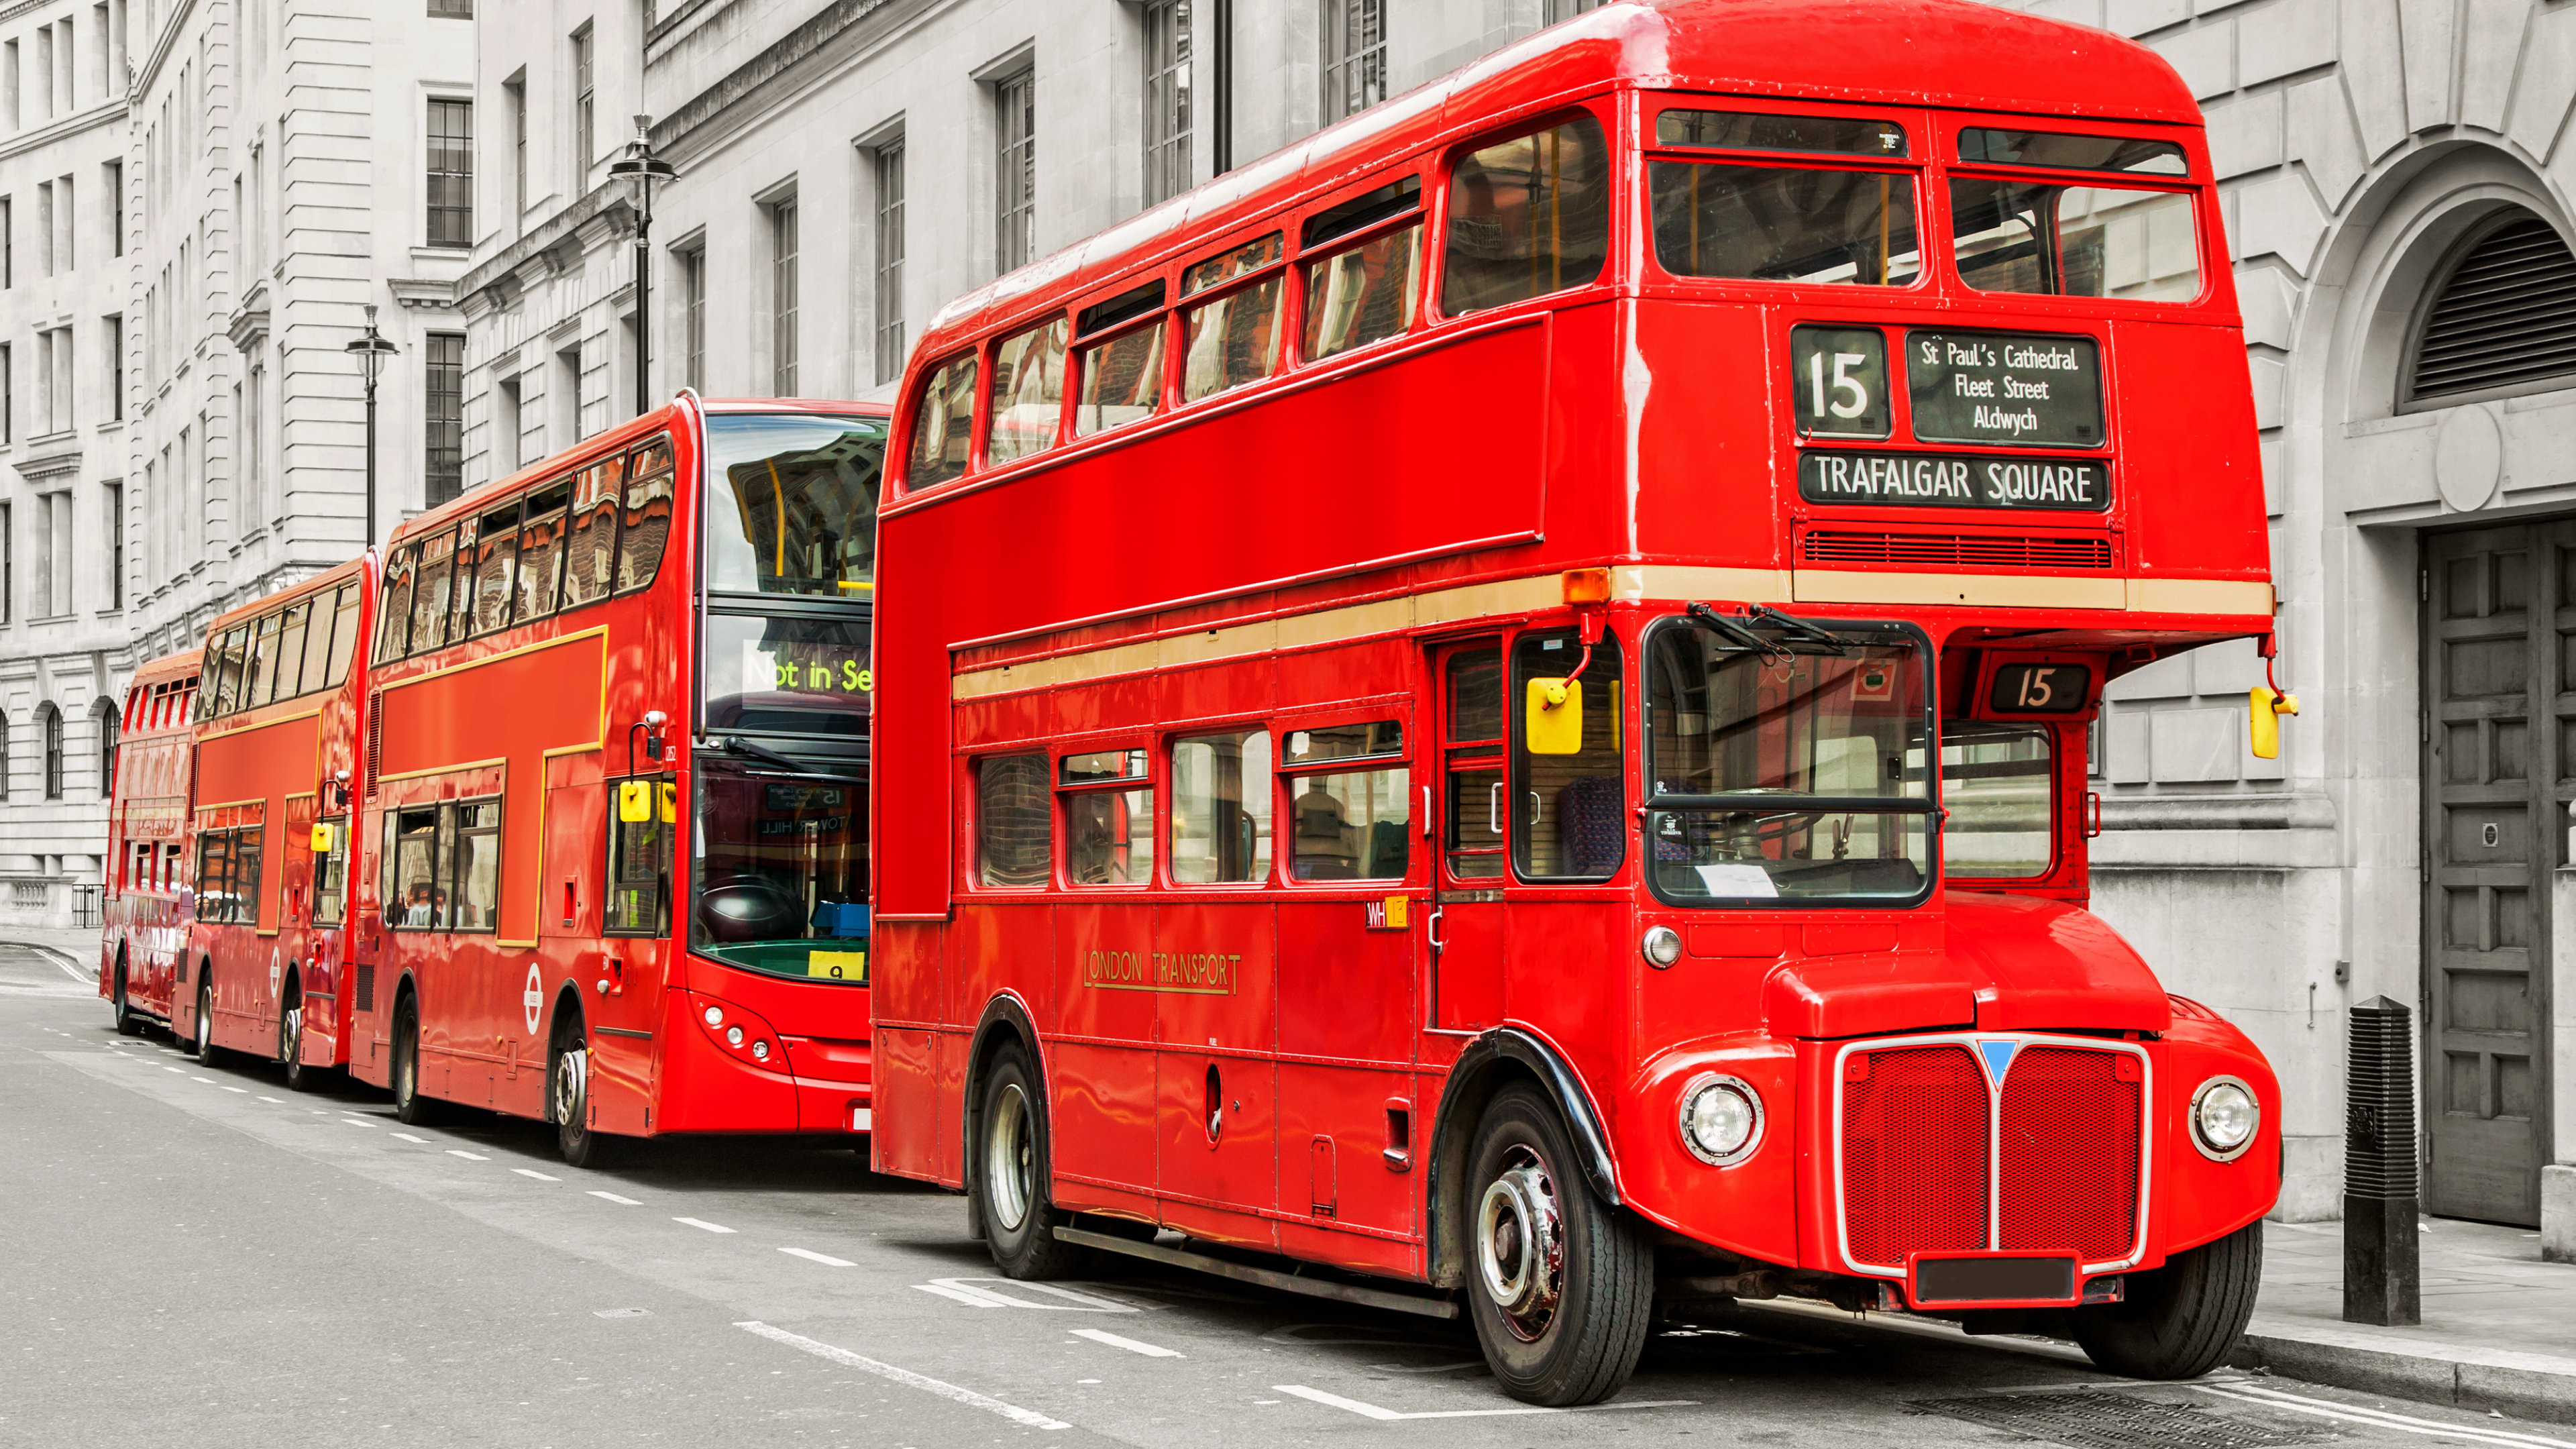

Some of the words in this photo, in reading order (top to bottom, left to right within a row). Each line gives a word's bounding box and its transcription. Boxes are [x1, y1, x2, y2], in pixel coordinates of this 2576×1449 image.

[1921, 341, 1939, 365] St
[1948, 345, 1996, 368] Paul's
[2004, 345, 2079, 370] Cathedral
[1811, 352, 1868, 419] 15
[1955, 374, 1995, 398] Fleet
[2004, 375, 2050, 400] Street
[1974, 405, 2038, 435] Aldwych
[1815, 456, 1972, 498] TRAFALGAR
[1988, 462, 2092, 502] SQUARE
[810, 661, 831, 689] in
[2019, 668, 2057, 706] 15
[1367, 902, 1385, 926] WH
[1084, 949, 1142, 987] LONDON
[1152, 952, 1240, 996] TRANSPORT
